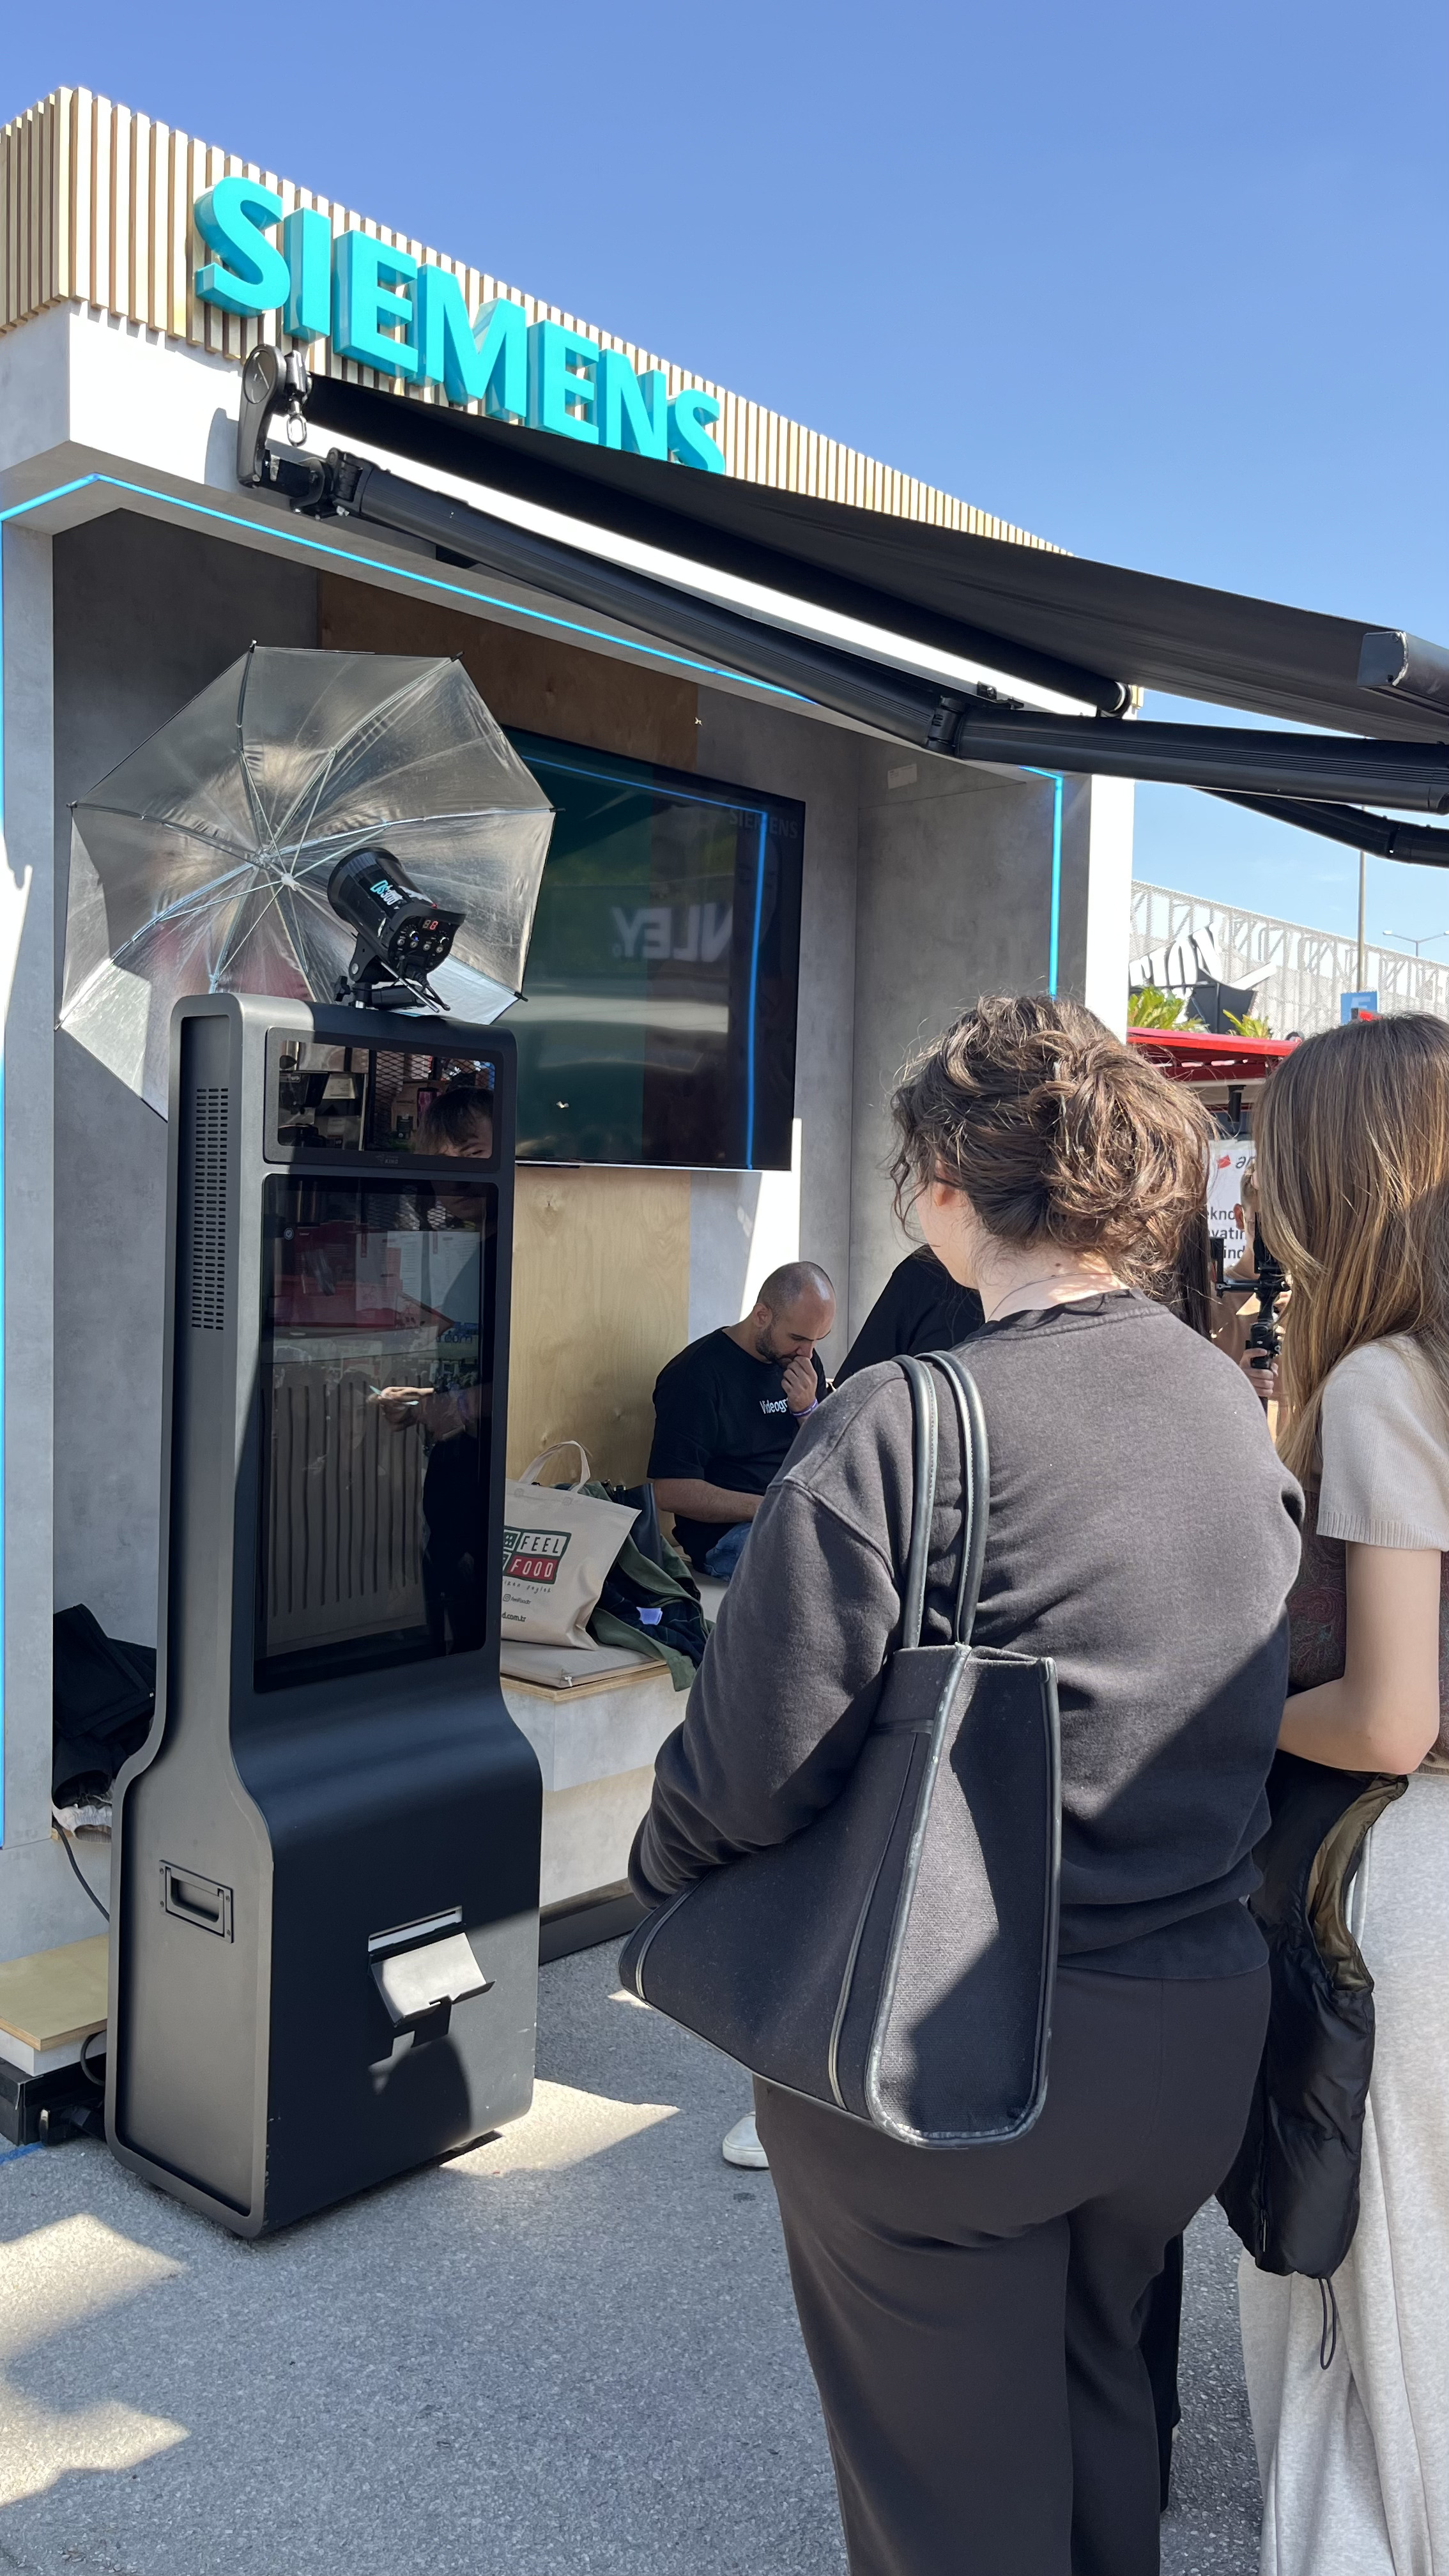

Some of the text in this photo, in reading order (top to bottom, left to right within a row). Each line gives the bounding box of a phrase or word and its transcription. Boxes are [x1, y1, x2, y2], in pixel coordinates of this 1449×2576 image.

[194, 176, 726, 475] SIEMENS
[520, 1535, 559, 1553] FEEL
[510, 1559, 553, 1577] FOOD
